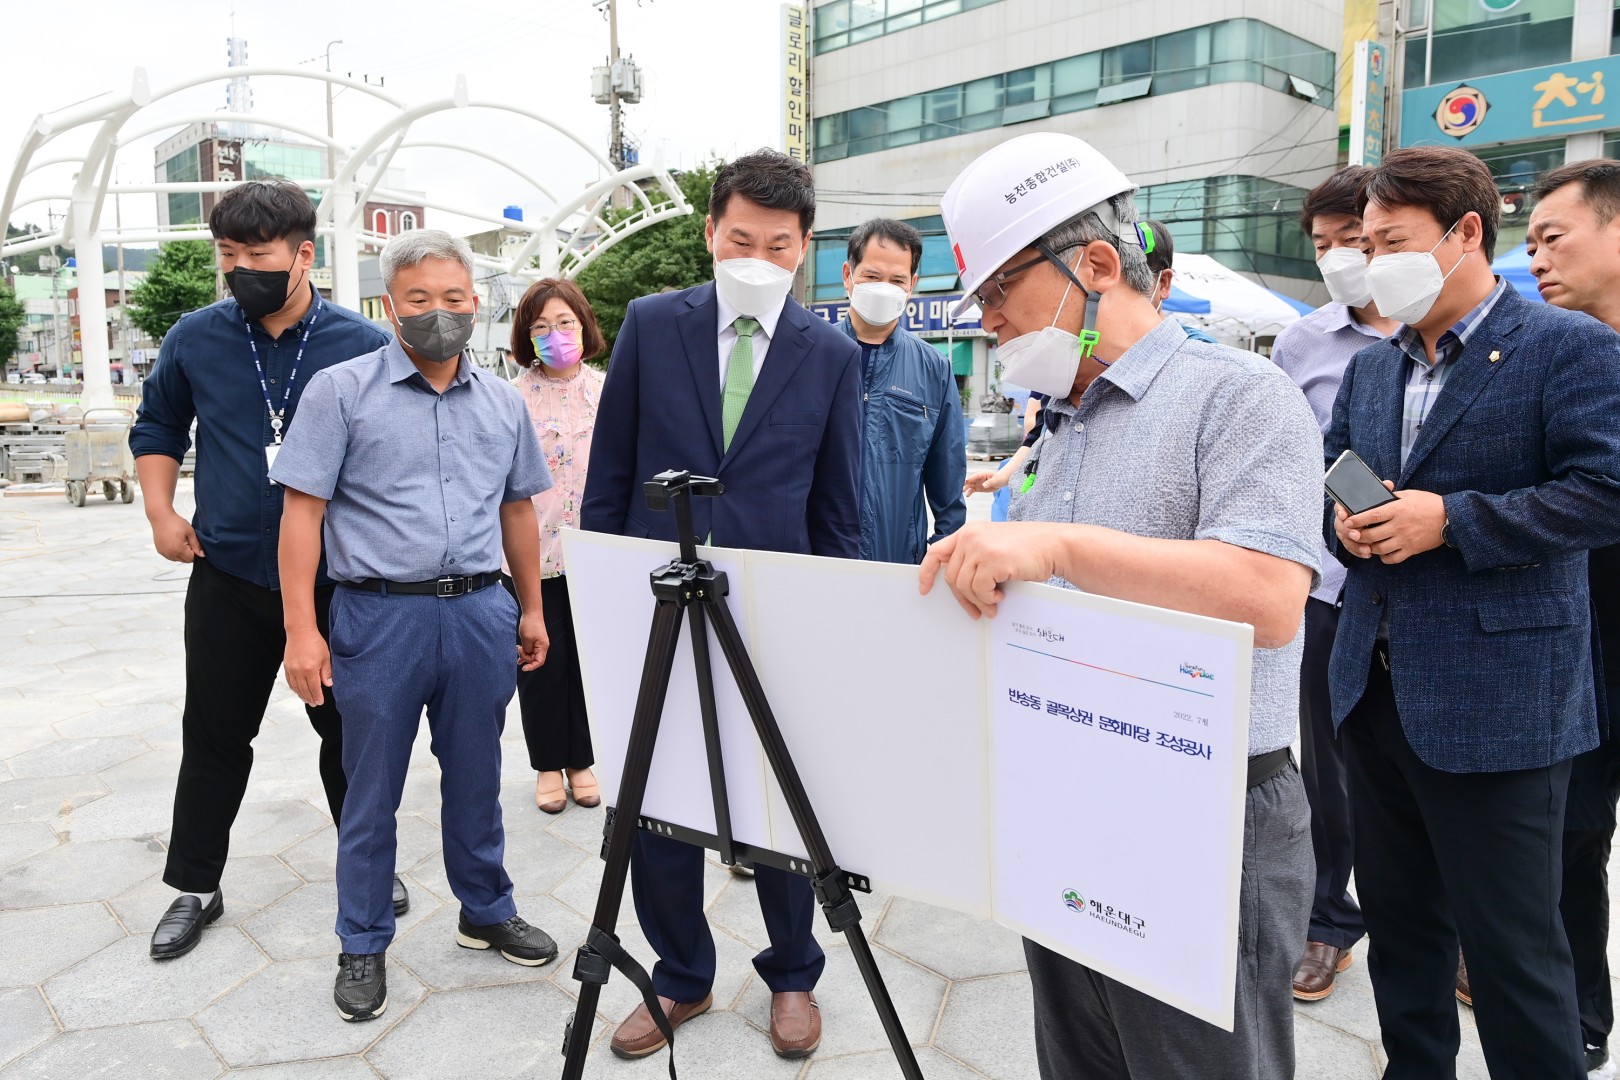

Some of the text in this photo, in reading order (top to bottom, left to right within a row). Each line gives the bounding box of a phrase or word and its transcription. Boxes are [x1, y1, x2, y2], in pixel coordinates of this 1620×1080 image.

[787, 7, 803, 160] 글로리할인마트
[1004, 157, 1081, 205] 능전종합건설(주)
[1008, 688, 1212, 760] 반송동 골목상권 문화마당 조성공사
[1089, 899, 1146, 930] 해운대구
[1089, 911, 1146, 939] HAEUNDAEGU
